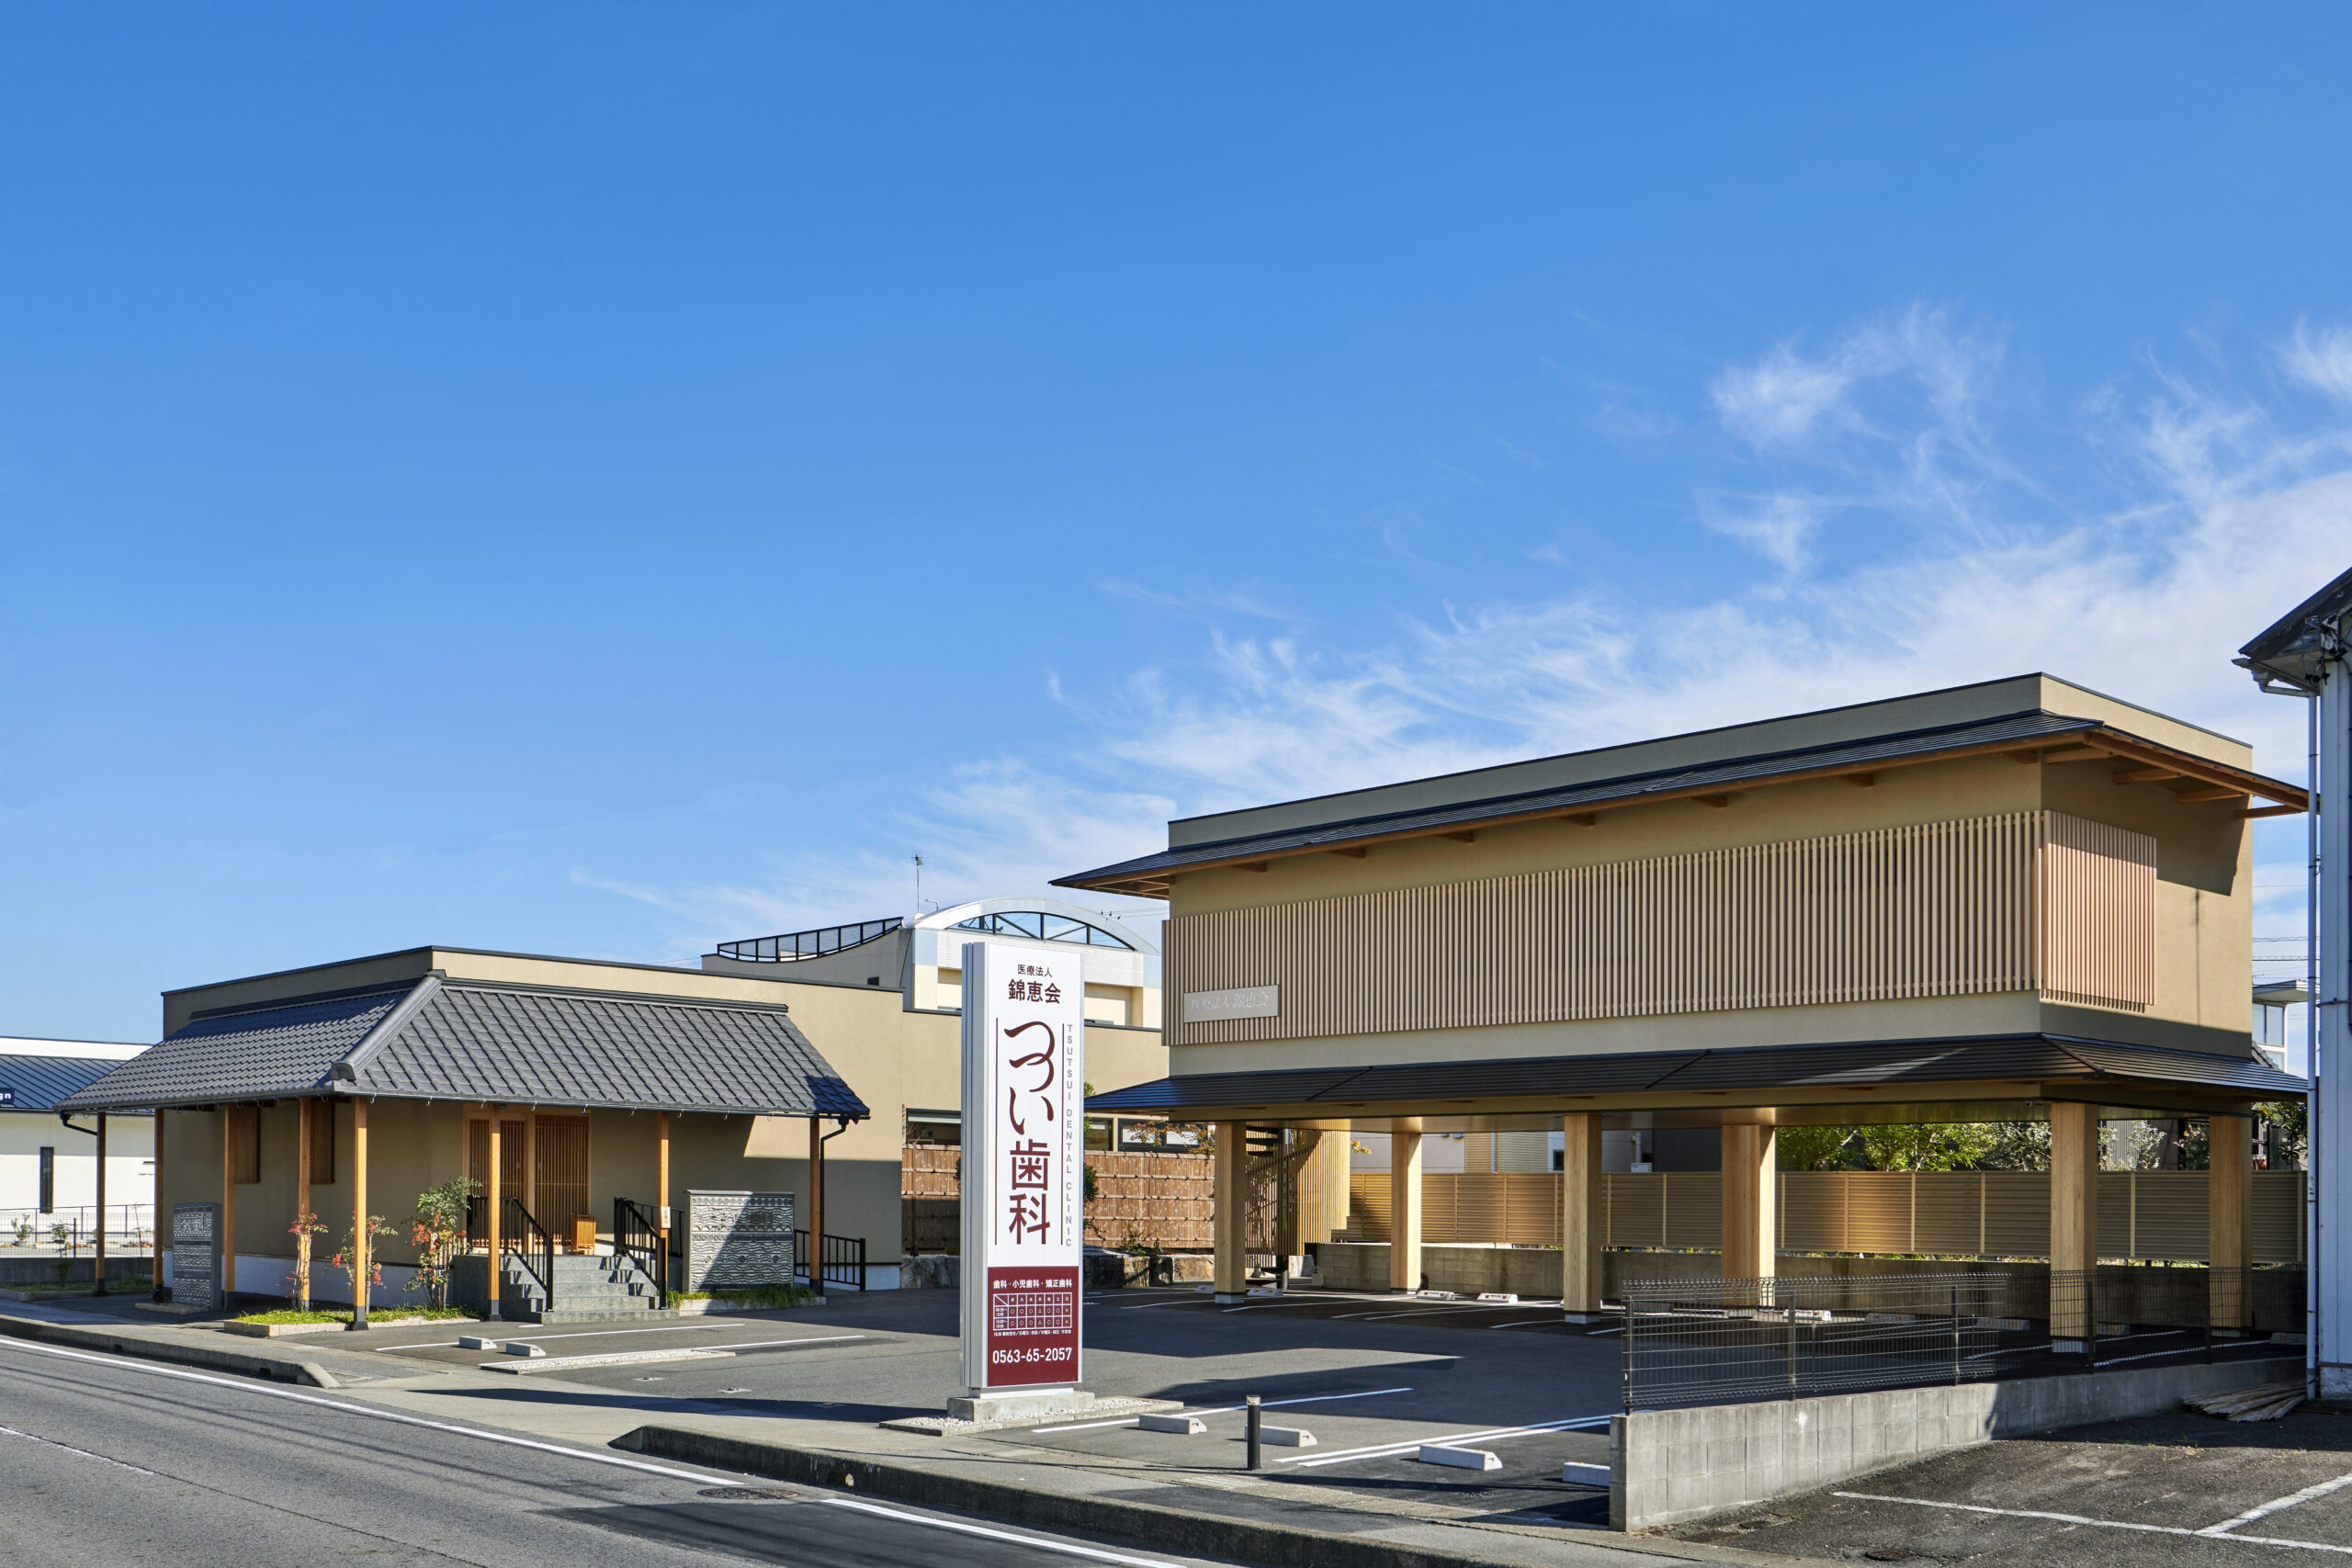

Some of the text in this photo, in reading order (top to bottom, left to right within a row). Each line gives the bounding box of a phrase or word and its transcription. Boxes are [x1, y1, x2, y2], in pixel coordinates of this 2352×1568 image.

[1017, 964, 1053, 977] 医療法人
[1008, 978, 1061, 1004] 錦恵会
[993, 1347, 1072, 1364] 0563-65-2057
